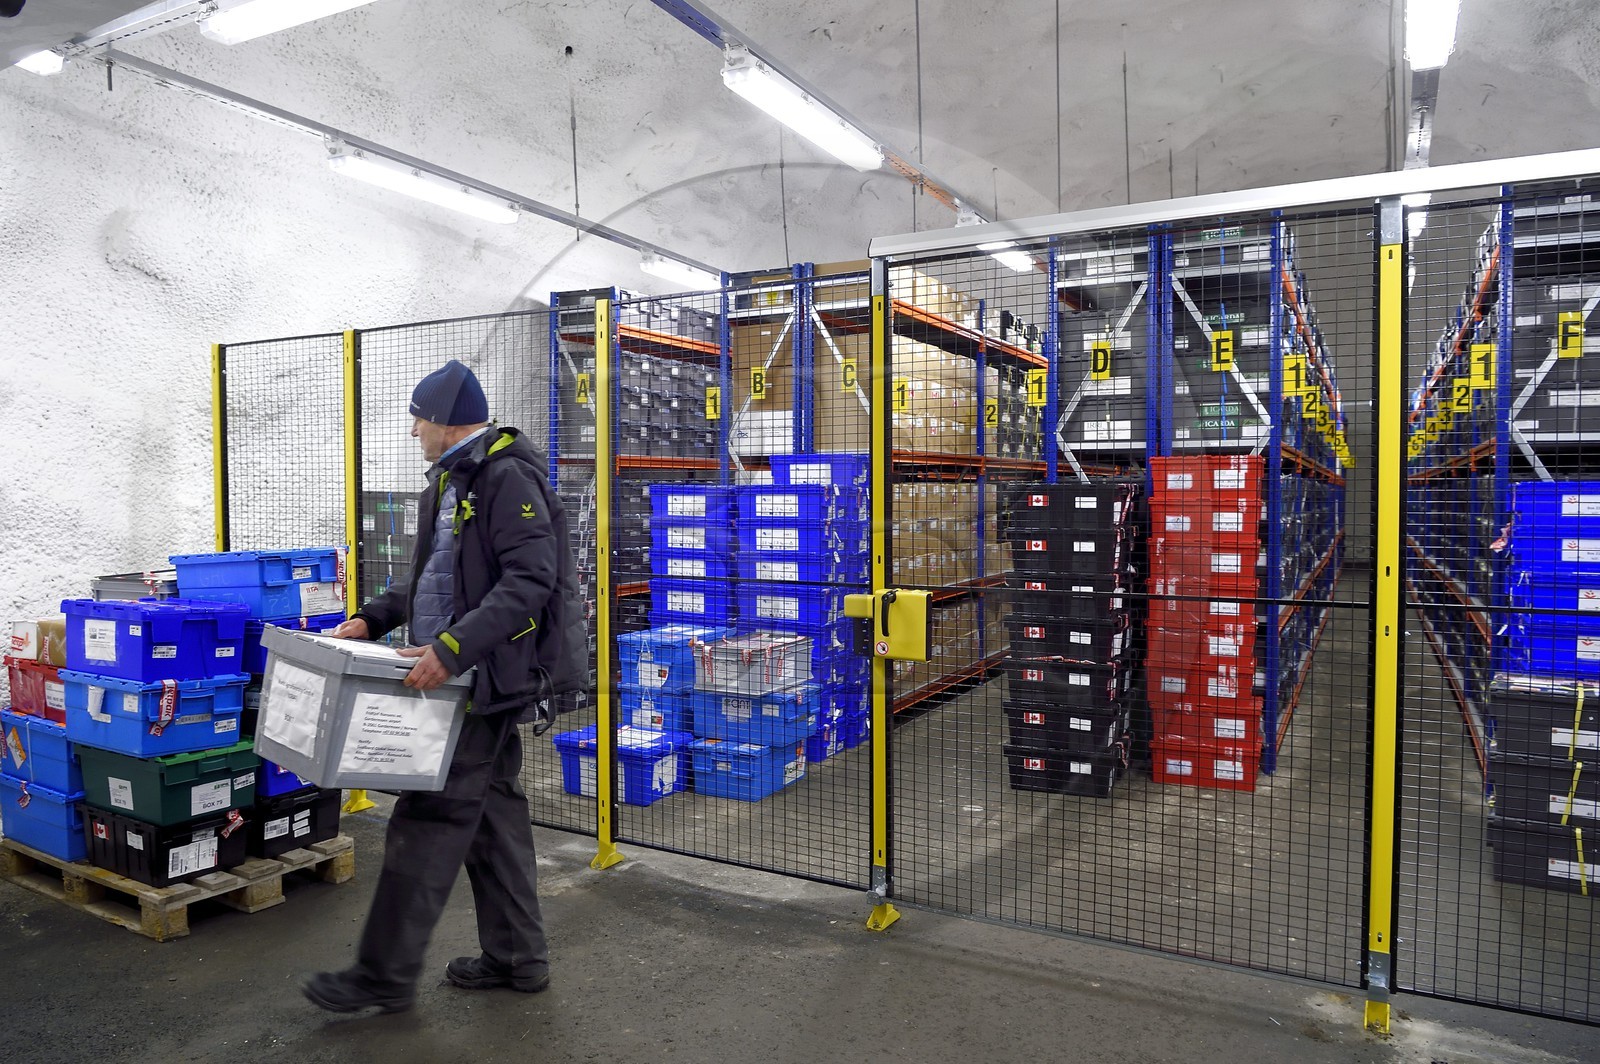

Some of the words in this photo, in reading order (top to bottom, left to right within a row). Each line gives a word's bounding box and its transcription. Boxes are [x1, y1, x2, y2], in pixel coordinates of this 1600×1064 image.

[1562, 321, 1580, 350] F
[1093, 349, 1108, 373] D
[1216, 338, 1230, 363] E
[843, 364, 854, 388] C
[1289, 363, 1300, 388] 1
[1477, 353, 1491, 380] 1
[578, 378, 588, 398] A
[753, 373, 763, 394] B
[1033, 376, 1043, 400] 1
[709, 394, 718, 414] 1
[896, 384, 905, 407] 1
[1305, 392, 1317, 412] 2
[1456, 385, 1469, 406] 2
[986, 404, 996, 422] 2
[1317, 410, 1327, 427] 3
[1440, 407, 1452, 424] 3
[1327, 424, 1335, 438] 4
[1428, 423, 1436, 436] 4
[165, 684, 176, 718] Jetpak
[202, 801, 215, 809] BOX
